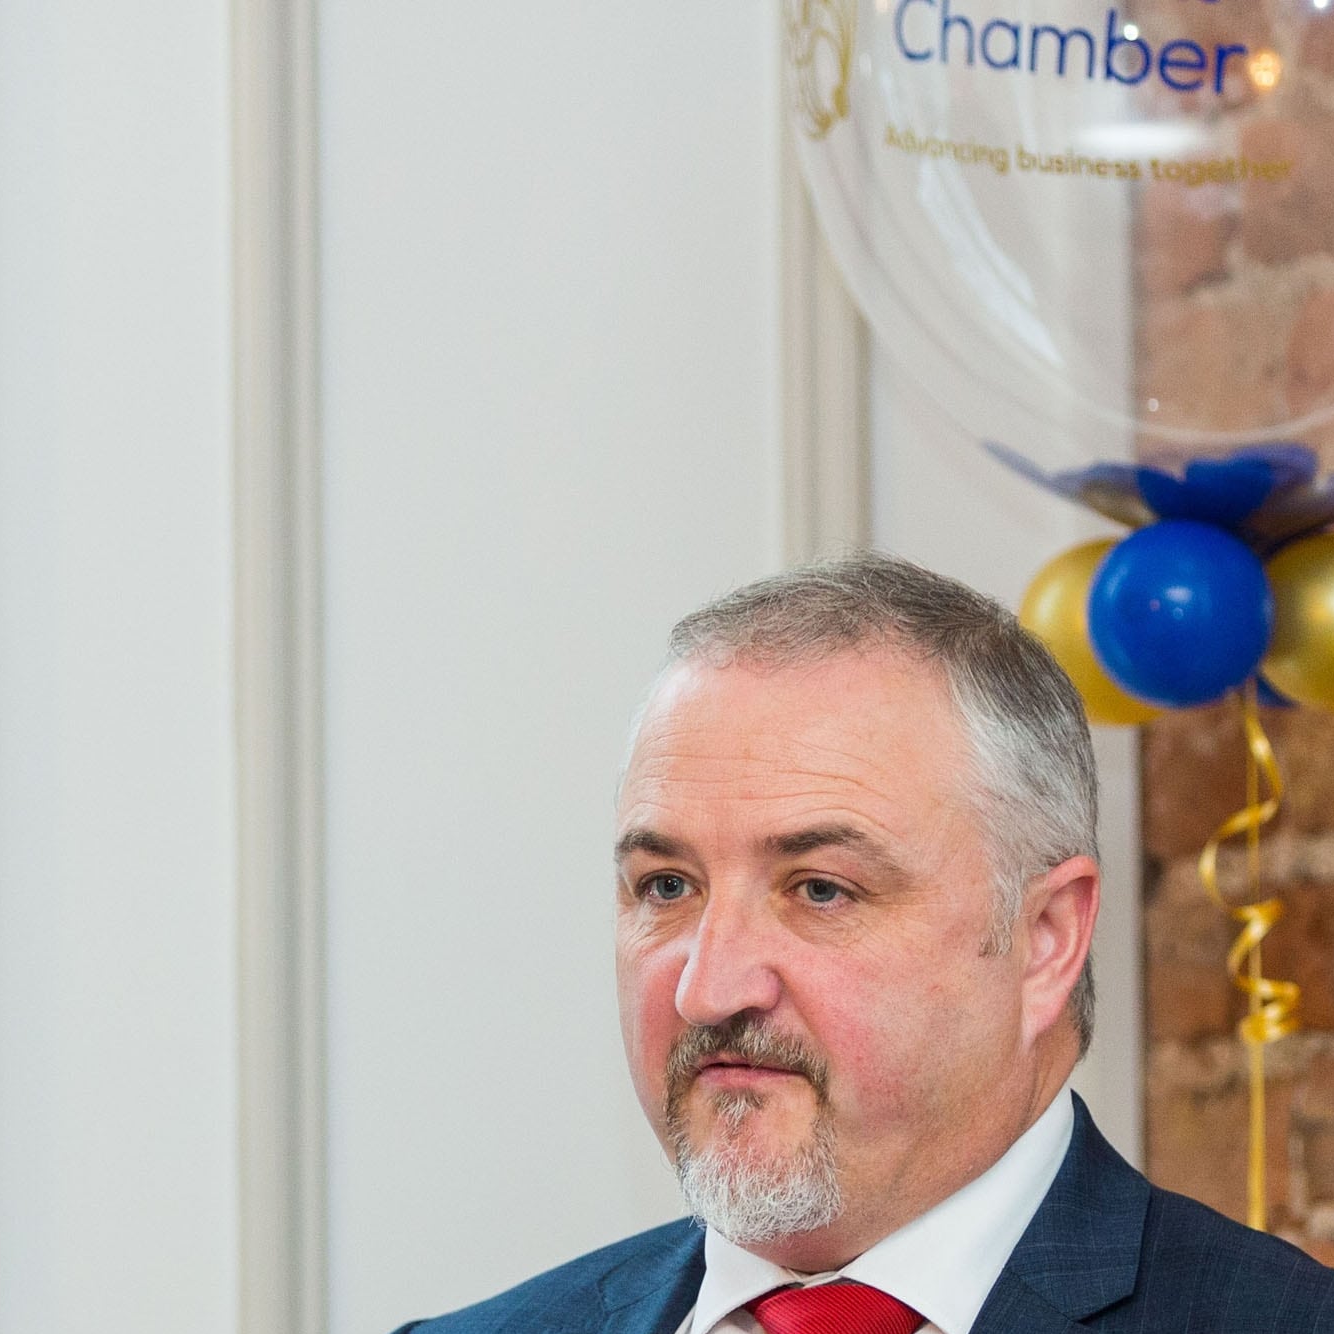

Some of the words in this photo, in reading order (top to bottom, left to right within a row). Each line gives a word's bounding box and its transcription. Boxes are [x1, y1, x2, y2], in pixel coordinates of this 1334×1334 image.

[894, 0, 1247, 94] Chamber
[1017, 144, 1142, 179] business
[1149, 155, 1295, 188] together
